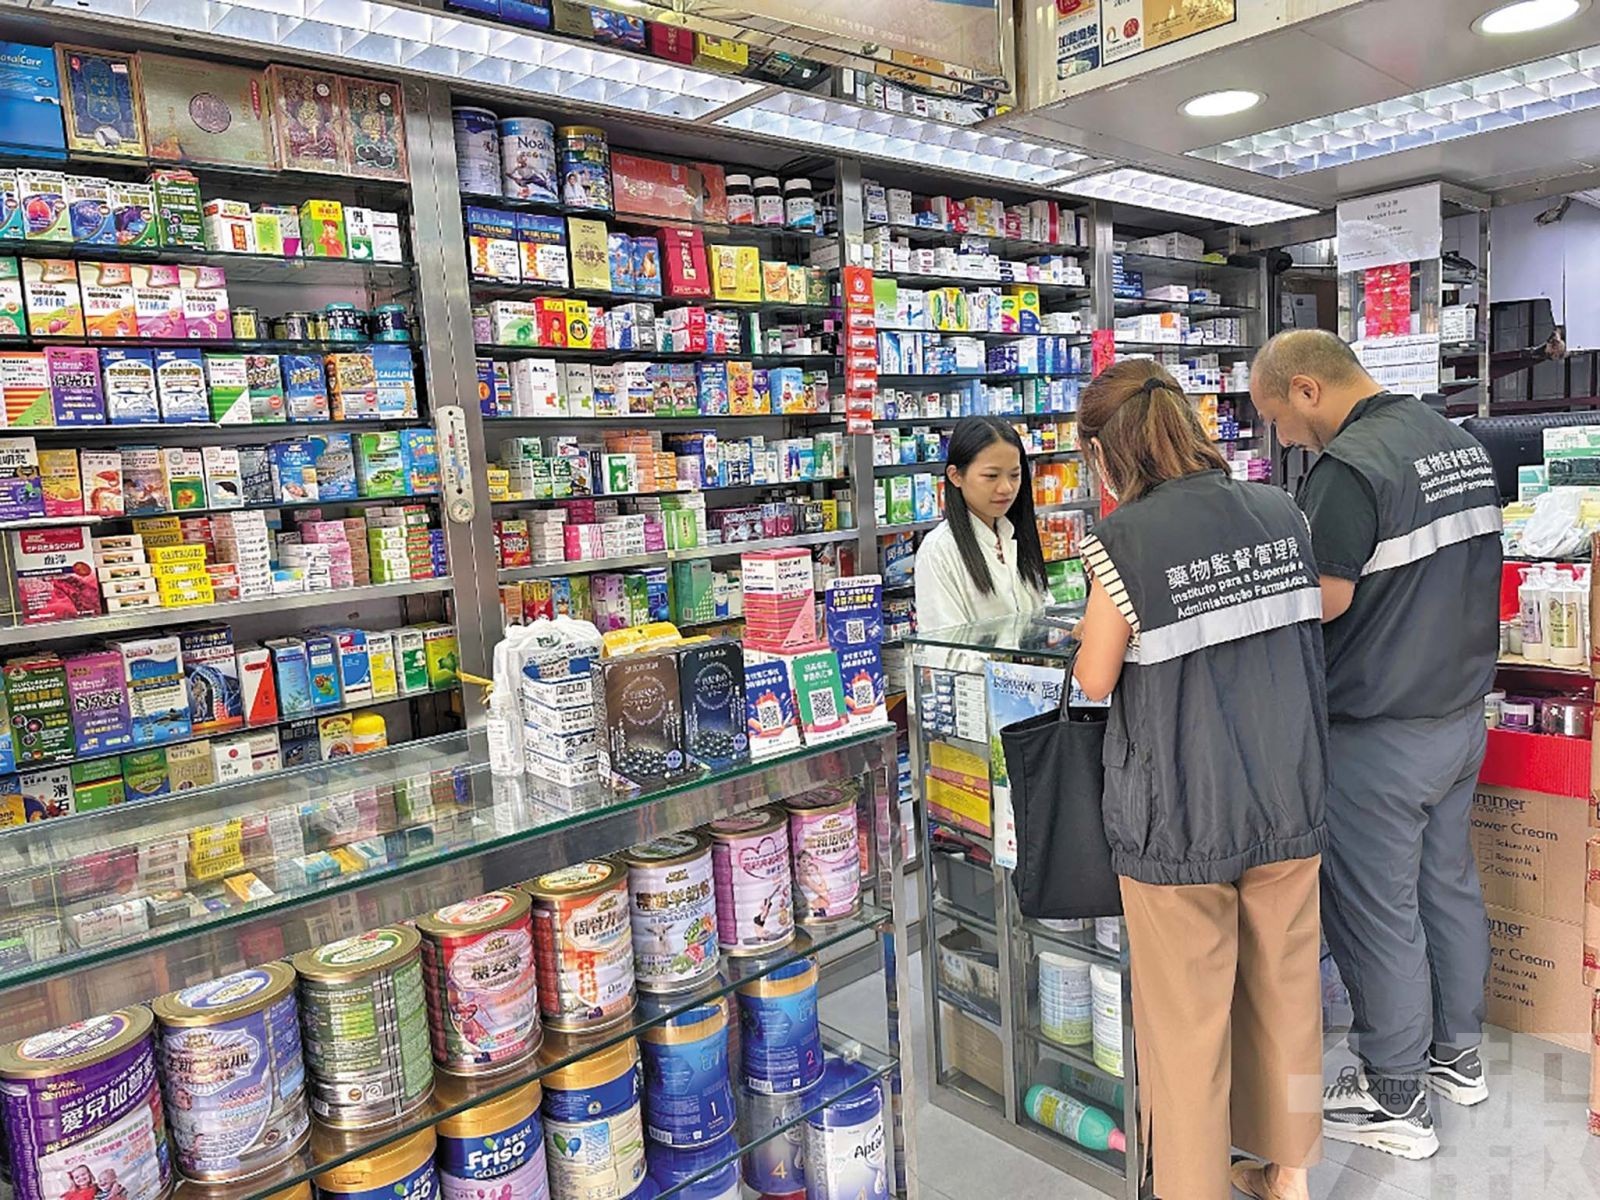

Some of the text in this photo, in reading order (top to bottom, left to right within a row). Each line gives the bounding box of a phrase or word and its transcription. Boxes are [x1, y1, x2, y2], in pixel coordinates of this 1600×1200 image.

[518, 136, 550, 150] Noah
[1165, 536, 1300, 590] 藥物監督管理局
[1171, 583, 1217, 605] Instituto
[1218, 575, 1243, 592] para
[1244, 573, 1252, 583] a
[1511, 823, 1558, 841] Cream
[1509, 948, 1556, 969] Cream
[806, 1050, 815, 1065] 2
[709, 1101, 717, 1117] 1
[465, 1142, 527, 1170] Friso
[473, 1163, 508, 1180] GOLD
[771, 1161, 787, 1179] 4
